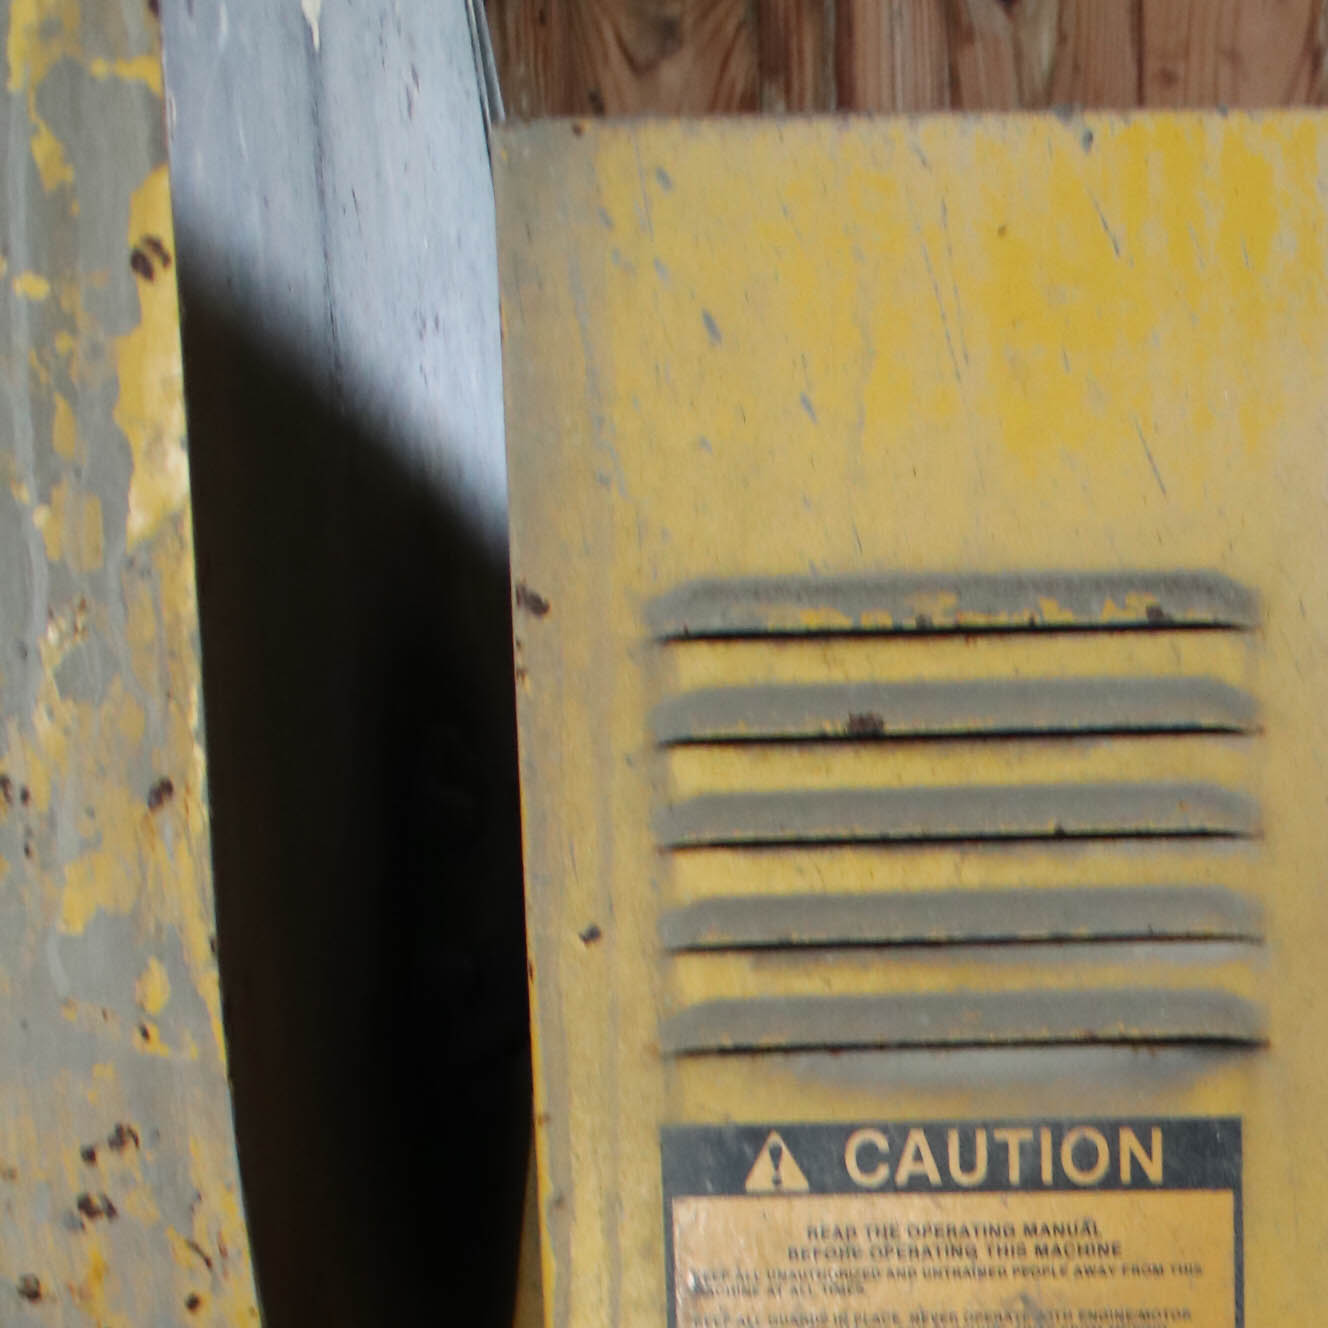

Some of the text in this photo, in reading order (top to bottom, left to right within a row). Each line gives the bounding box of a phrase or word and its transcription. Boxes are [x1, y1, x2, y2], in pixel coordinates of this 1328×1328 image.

[844, 1126, 1166, 1187] CAUTION
[907, 1221, 1016, 1239] OPERATING
[1022, 1220, 1100, 1237] MANUAL
[787, 1240, 1121, 1262] BEFORE OPERATING THIS MACHINE
